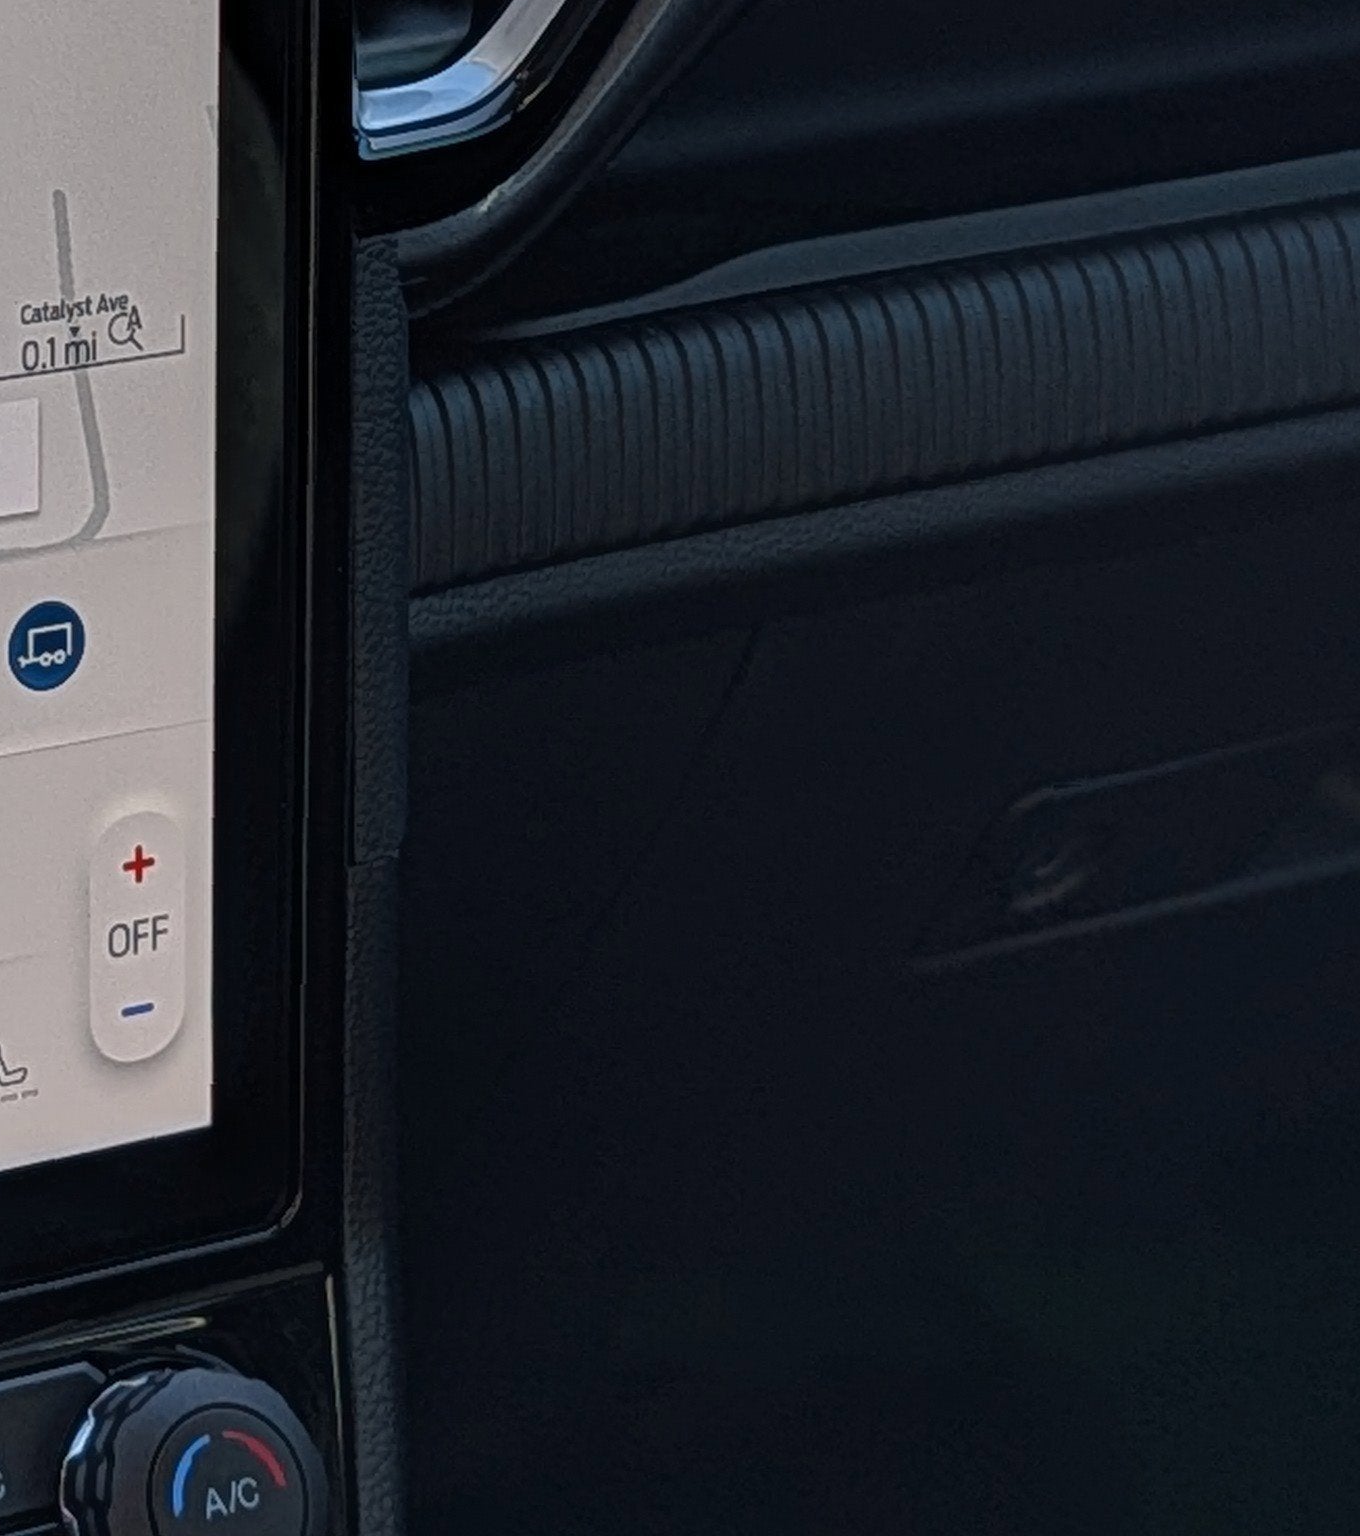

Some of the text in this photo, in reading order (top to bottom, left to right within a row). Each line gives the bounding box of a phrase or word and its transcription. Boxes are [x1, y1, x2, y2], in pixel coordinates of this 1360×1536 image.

[20, 292, 130, 326] Catalyst Ave
[21, 331, 98, 372] 0.1 mi
[108, 914, 170, 959] OFF
[205, 1476, 261, 1521] A/C
